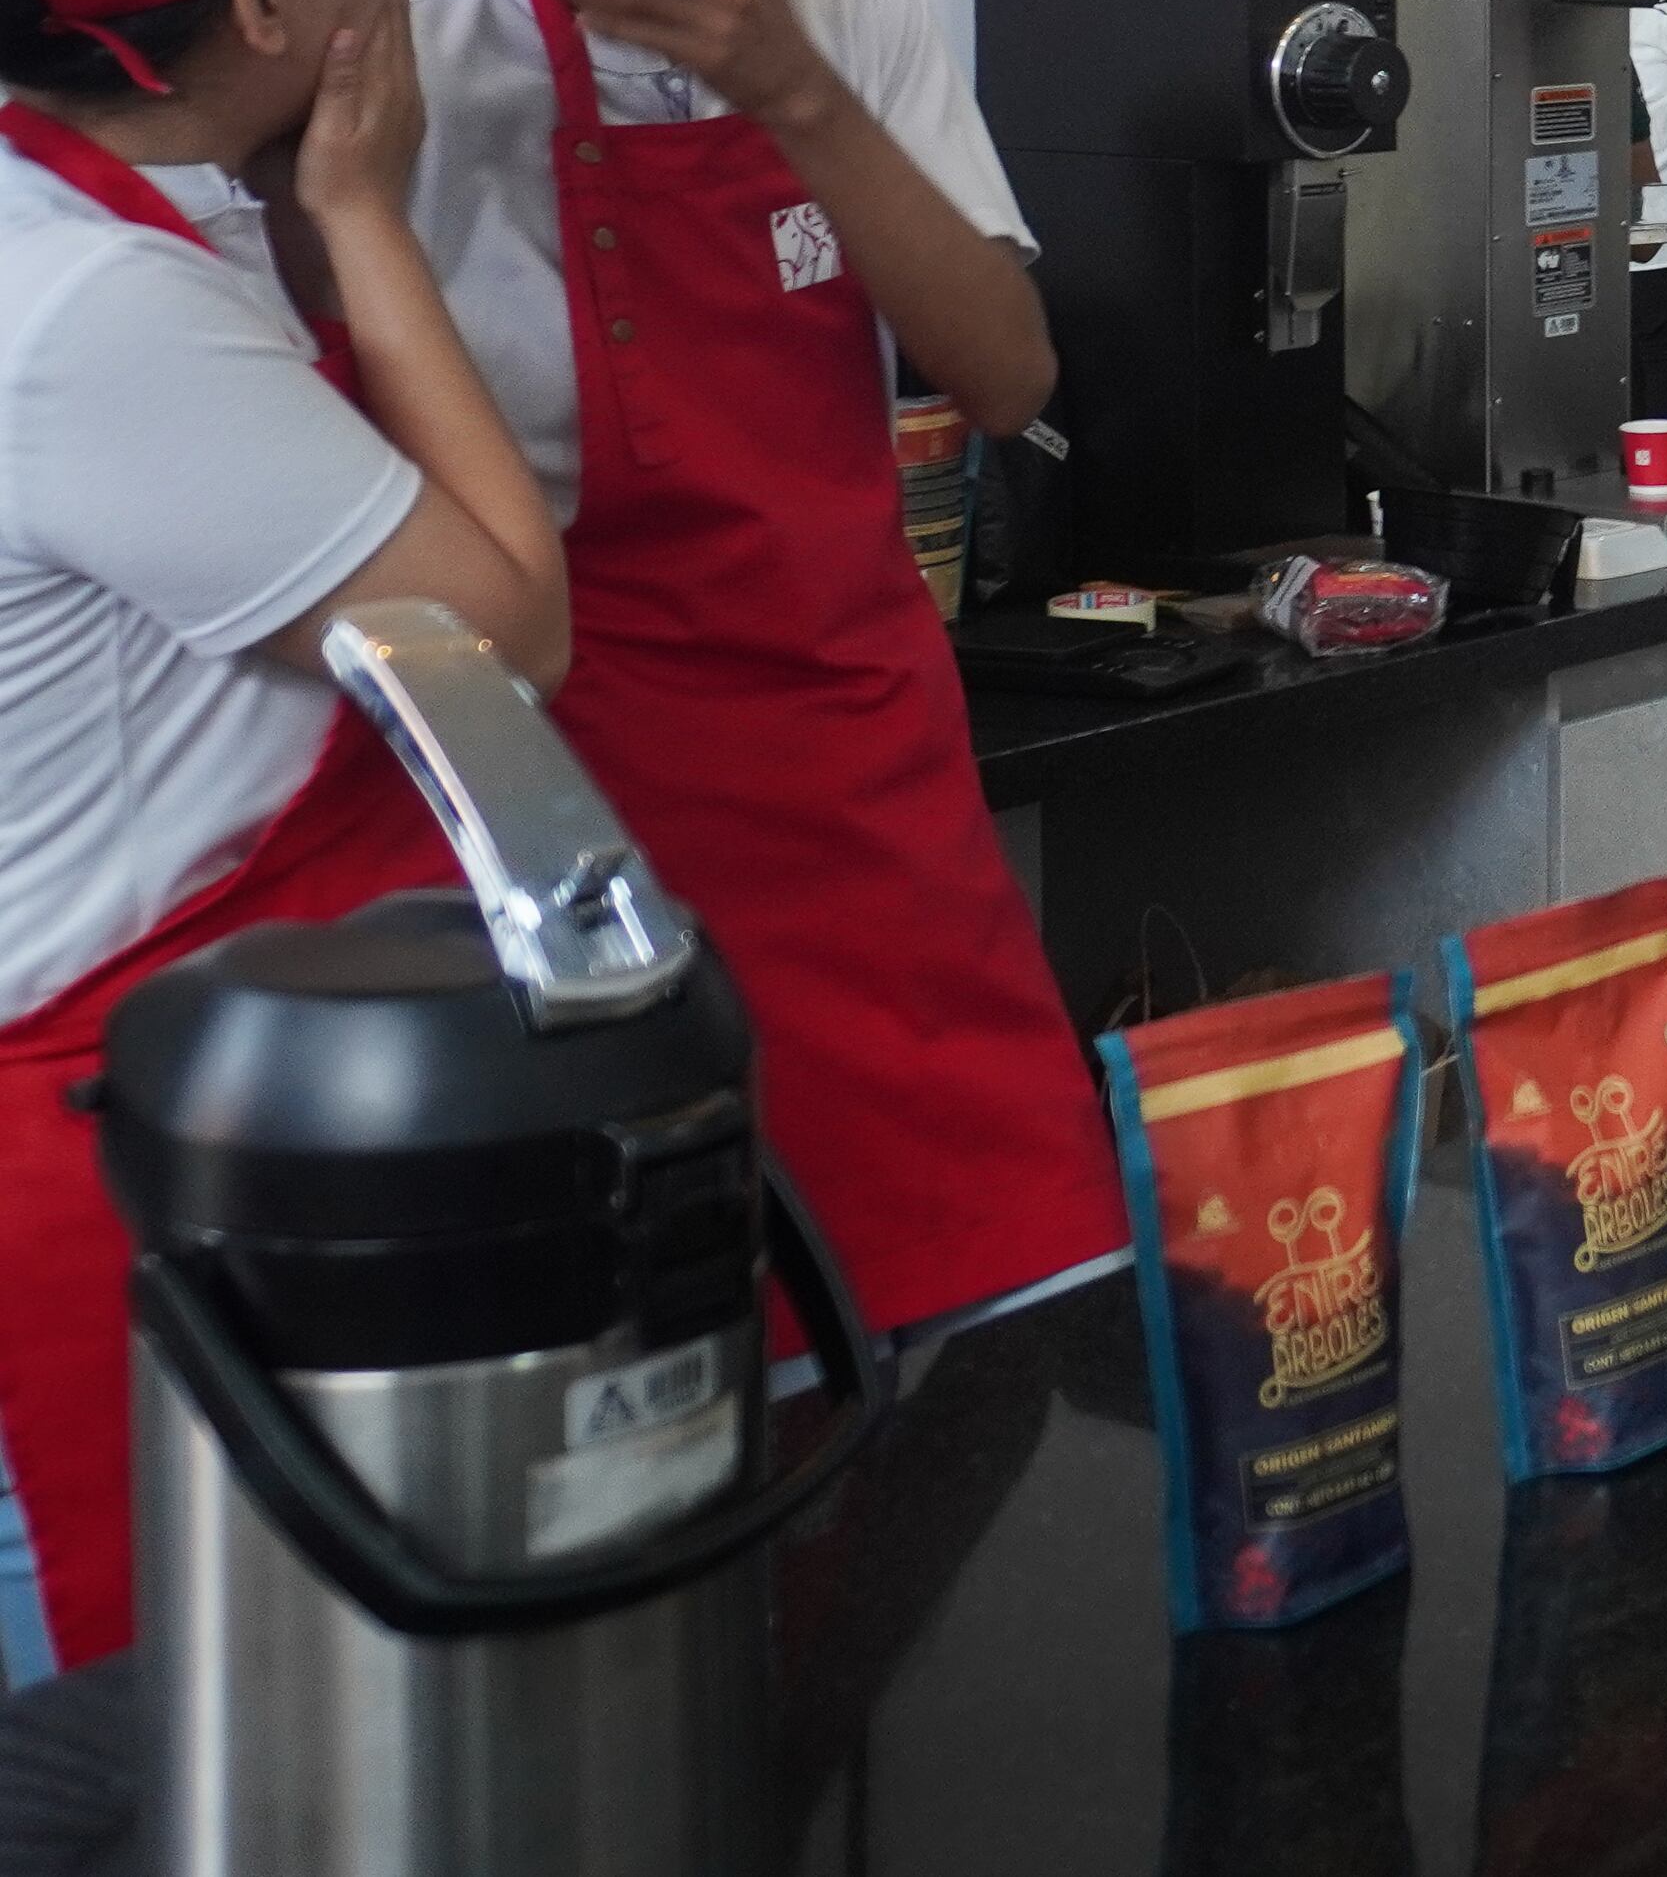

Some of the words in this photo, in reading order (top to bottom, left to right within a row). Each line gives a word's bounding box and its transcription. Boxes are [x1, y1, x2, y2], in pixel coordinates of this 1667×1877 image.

[1264, 1254, 1382, 1333] ENTRE
[1571, 1302, 1631, 1336] ORIGEN
[1253, 1438, 1321, 1477] ORIGEN
